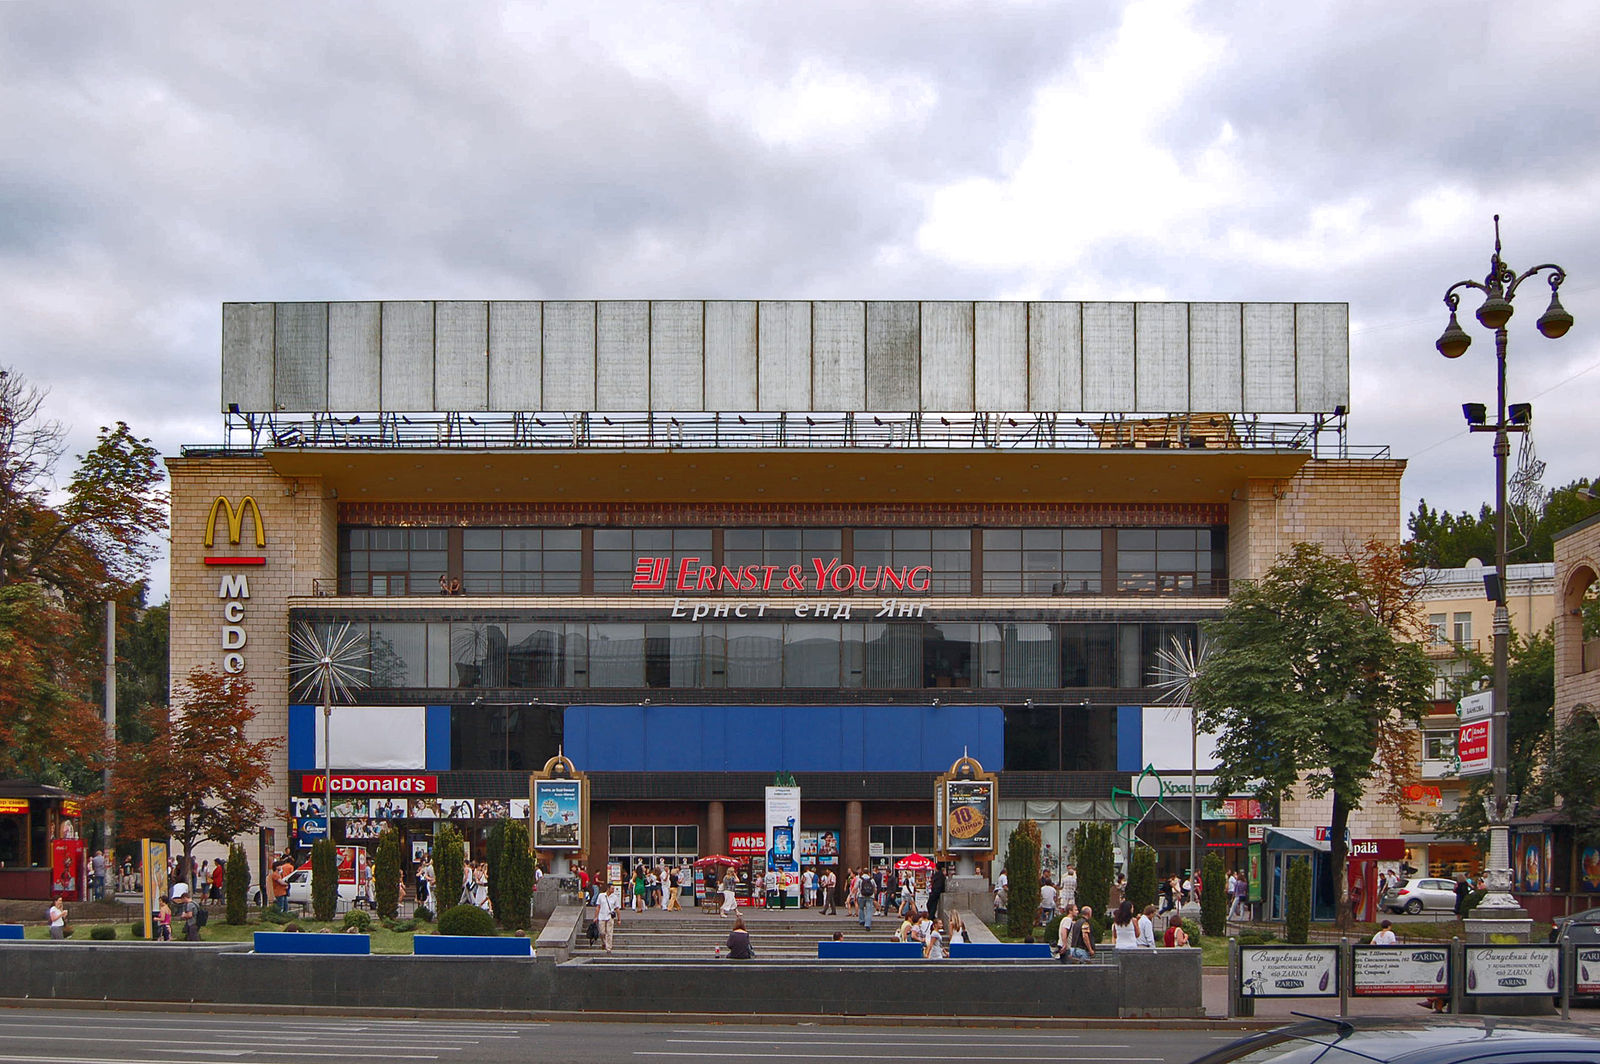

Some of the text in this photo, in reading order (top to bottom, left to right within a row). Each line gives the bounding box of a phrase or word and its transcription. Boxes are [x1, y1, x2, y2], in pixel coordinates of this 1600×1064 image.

[782, 564, 807, 591] &
[671, 598, 931, 622] Ернст енд Янг
[312, 775, 426, 792] McDonald's
[953, 807, 972, 825] 10
